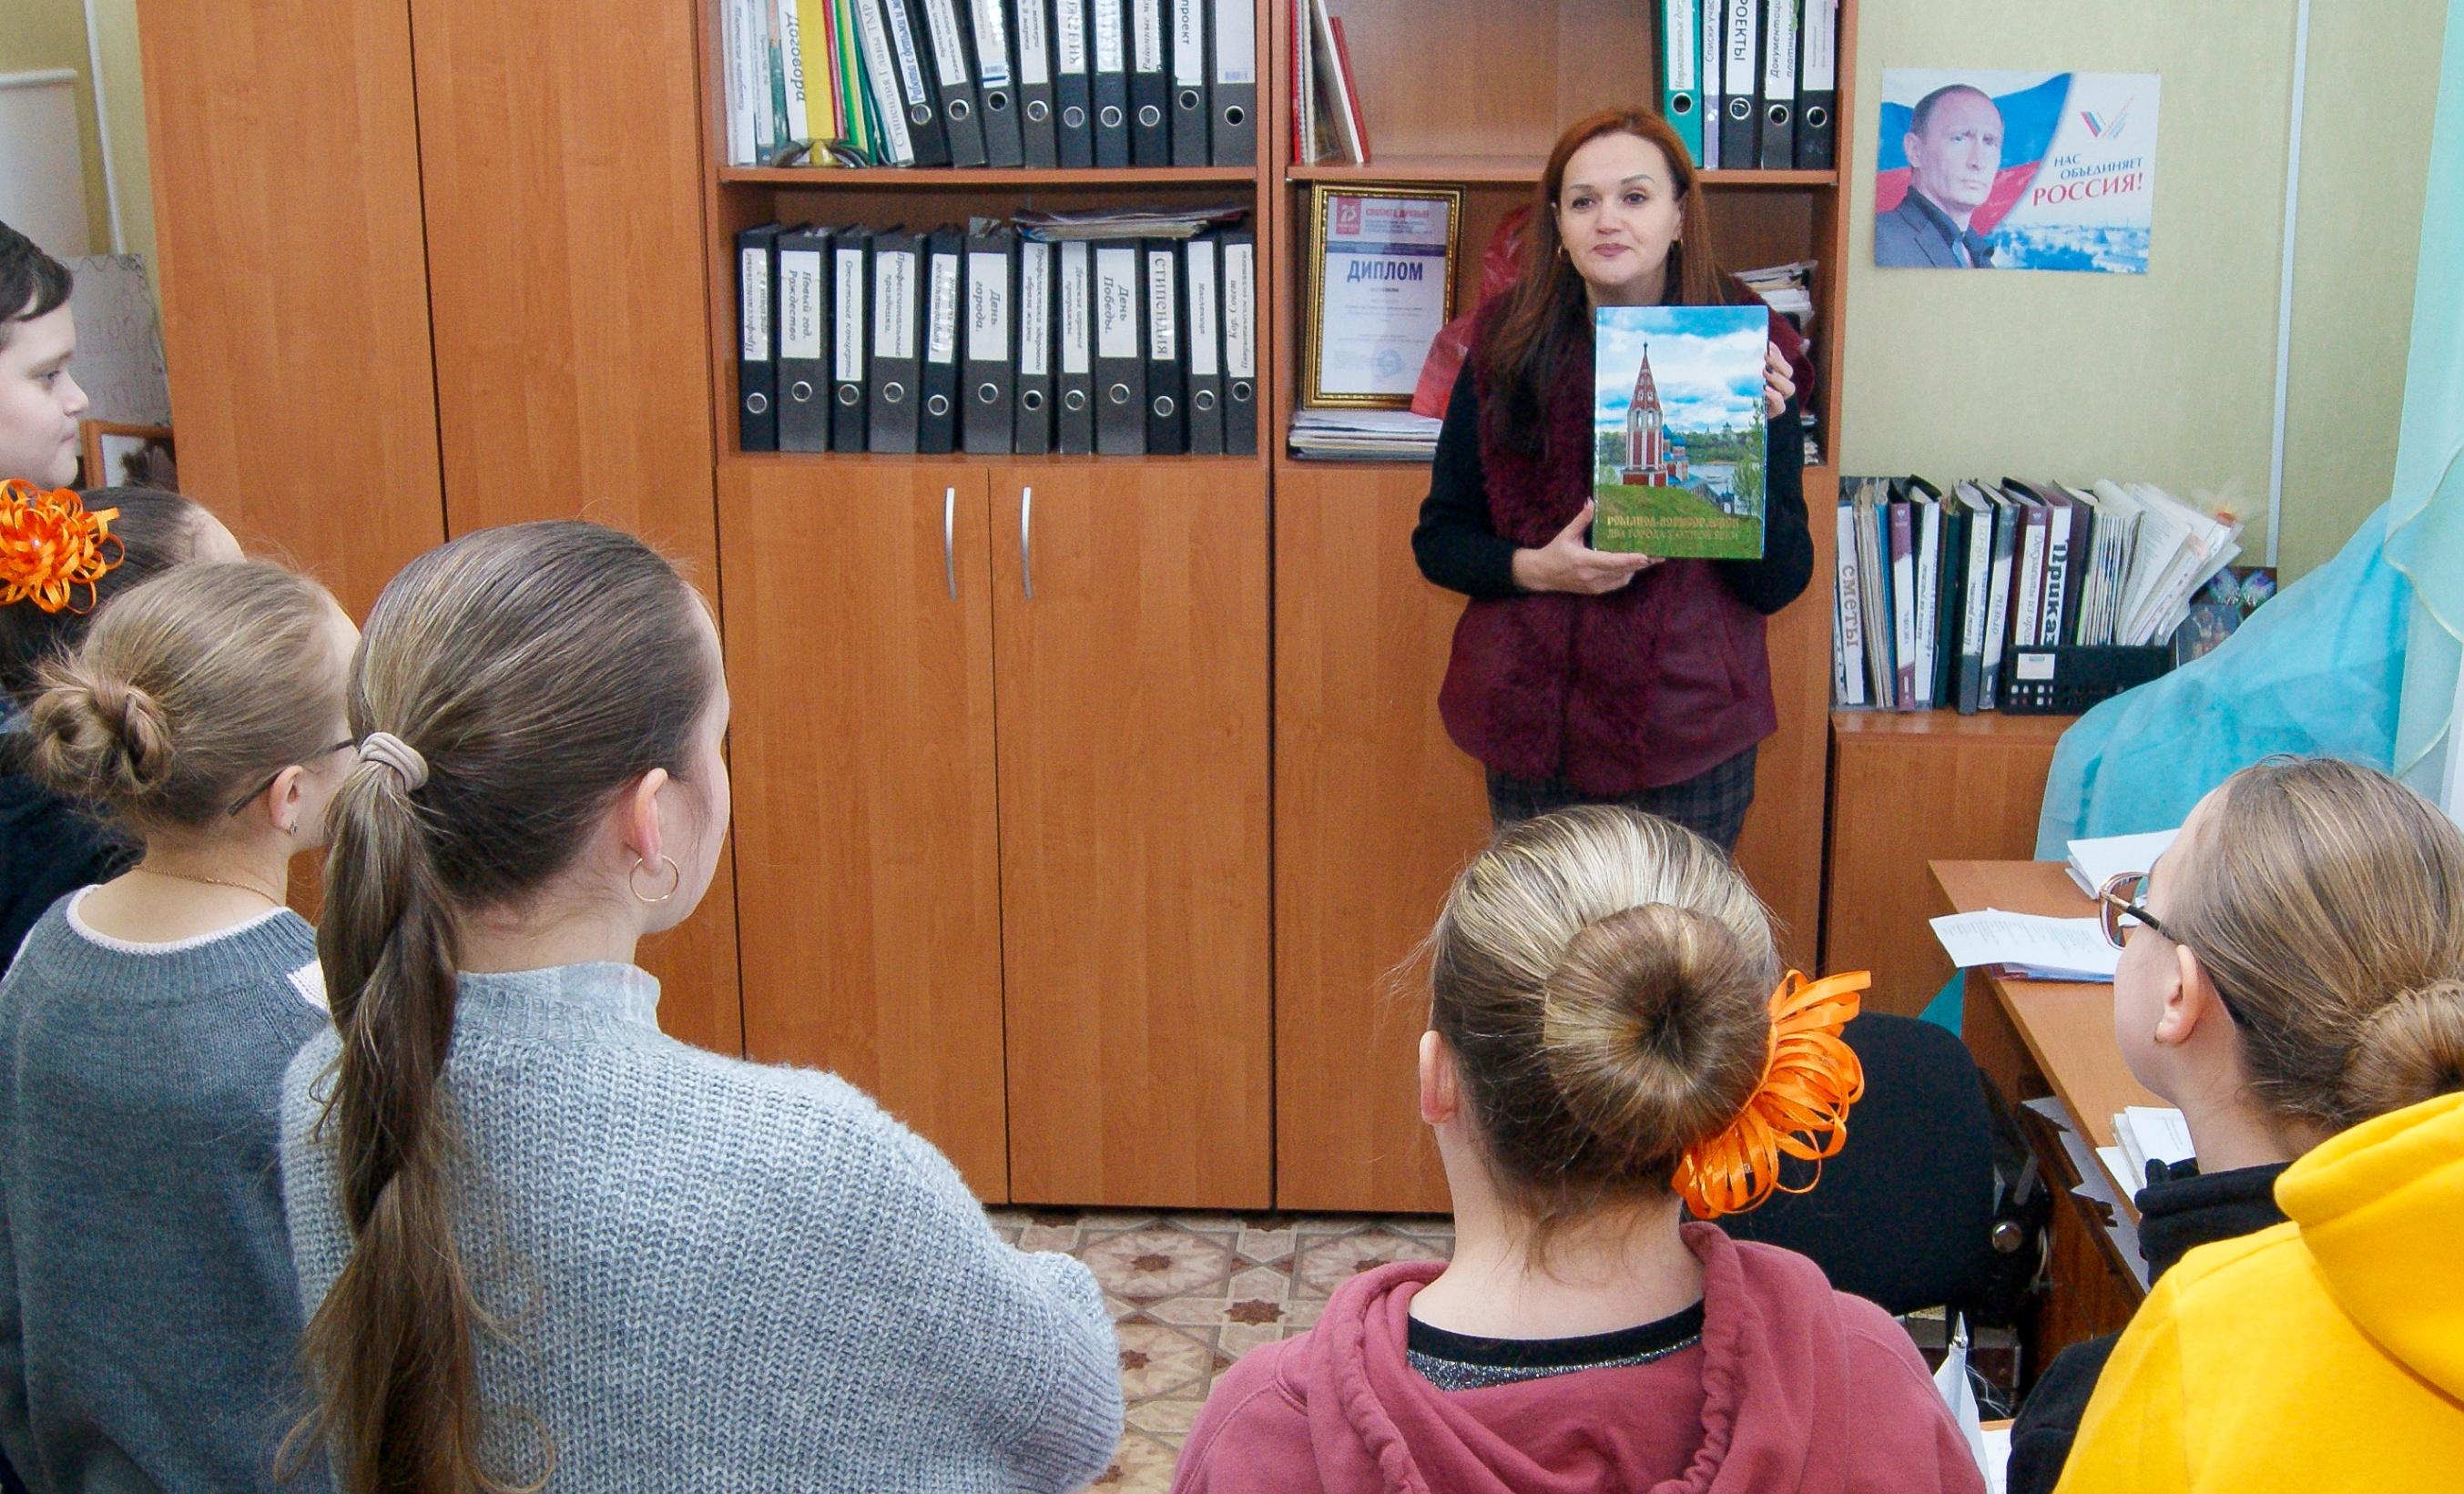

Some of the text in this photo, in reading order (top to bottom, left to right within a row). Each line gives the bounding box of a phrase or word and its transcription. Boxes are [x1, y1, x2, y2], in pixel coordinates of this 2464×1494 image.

[785, 13, 806, 103] Договора
[1142, 18, 1152, 70] Районные
[1705, 25, 1715, 63] Списки
[862, 3, 906, 147] Стипендия Главы ТМР
[908, 64, 923, 102] Работа
[2053, 153, 2082, 168] НАС
[2060, 157, 2143, 180] ОБЪЕДИНЯЕТ
[2031, 172, 2143, 207] РОССИЯ!
[1347, 259, 1423, 282] ДИПЛОМ
[787, 269, 798, 341] Рождество
[802, 271, 812, 340] Новый год.
[843, 260, 853, 379] Отчетные концерты
[894, 252, 905, 357] Профессиональные
[975, 280, 986, 333] города.
[990, 290, 1001, 326] День
[1034, 248, 1044, 371] Профилактика здорового
[1103, 276, 1115, 334] Победы.
[1118, 285, 1130, 321] День
[1198, 282, 1207, 335] Масленица
[2029, 534, 2044, 598] Документы
